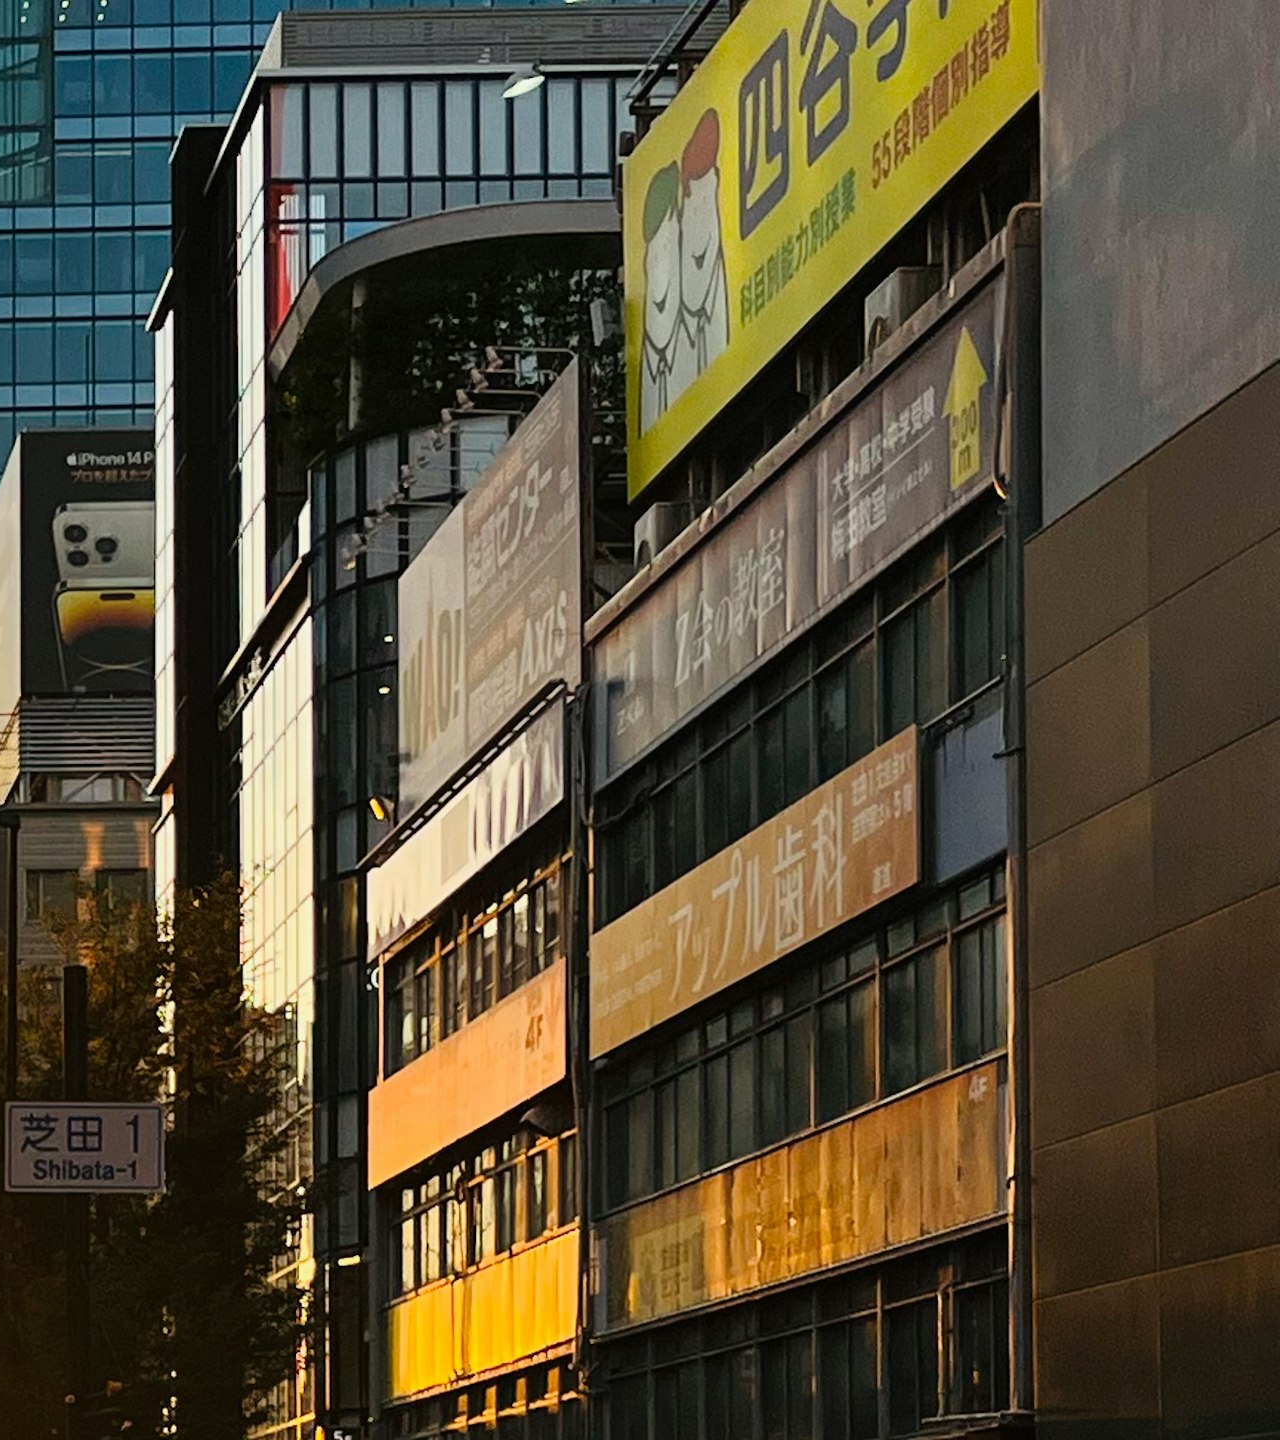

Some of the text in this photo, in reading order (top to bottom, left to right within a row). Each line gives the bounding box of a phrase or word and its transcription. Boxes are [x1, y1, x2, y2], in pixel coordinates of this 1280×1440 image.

[739, 0, 950, 240] 四谷
[872, 0, 1011, 190] 55段階個別指導
[740, 166, 856, 328] 科目別能力別授業
[79, 452, 125, 466] iPhone
[127, 451, 141, 464] 14
[674, 527, 786, 688] Z会の教室
[668, 793, 847, 1001] アップル歯科
[525, 1013, 544, 1053] 4F
[20, 1113, 140, 1153] 芝田 1
[32, 1158, 138, 1181] Shibata-1
